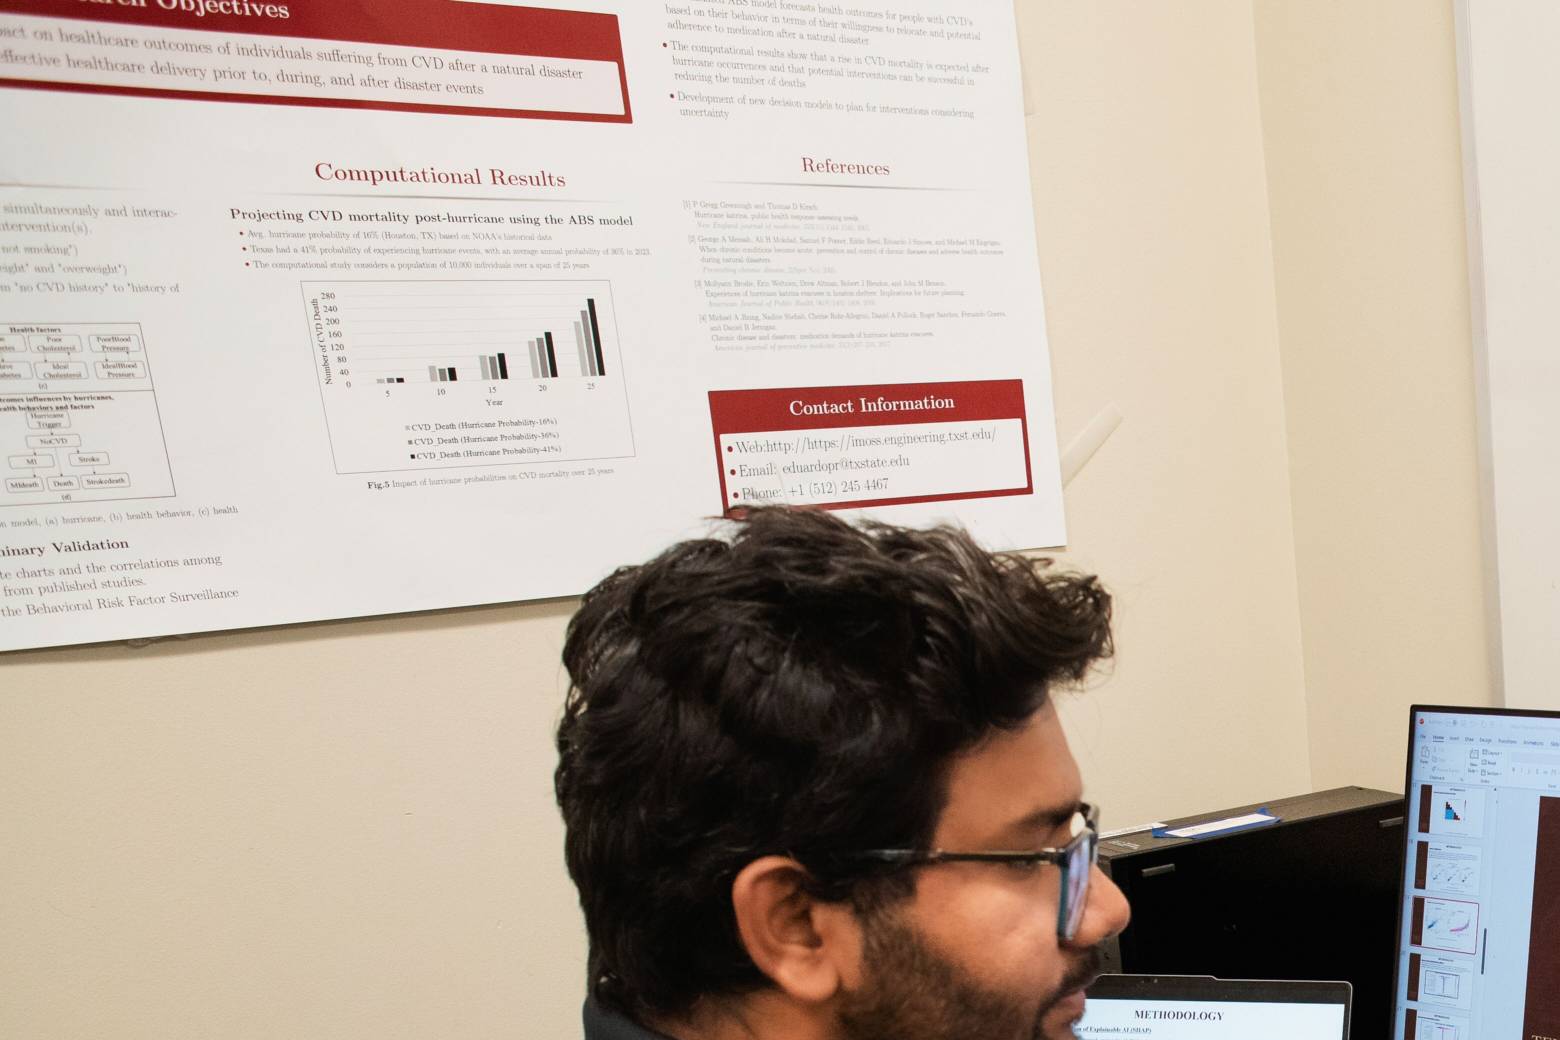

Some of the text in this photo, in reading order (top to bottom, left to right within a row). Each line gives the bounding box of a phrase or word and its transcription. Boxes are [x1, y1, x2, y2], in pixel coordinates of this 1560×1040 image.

[150, 0, 290, 19] Objectives
[665, 4, 691, 17] based
[731, 11, 768, 24] behavior
[33, 27, 584, 80] on healthcare outcomes of individuals suffering from CVD after a natural disaster
[65, 54, 145, 74] healthcare
[150, 60, 207, 79] delivery
[213, 67, 247, 82] prior
[330, 73, 355, 87] and
[359, 75, 389, 89] after
[394, 77, 441, 93] disaster
[445, 83, 485, 95] events
[315, 162, 566, 187] Computational Results
[801, 156, 890, 177] References
[3, 202, 178, 219] simultaneously and interac-
[230, 208, 634, 226] Projecting CVD mortality post-hurricane using the ABS model
[36, 282, 65, 293] CVD
[113, 282, 125, 293] to
[322, 305, 338, 313] 240
[325, 318, 340, 326] 200
[311, 298, 333, 385] Number of CVD Death
[436, 388, 446, 396] 10
[538, 384, 547, 392] 20
[486, 398, 504, 407] Year
[789, 395, 955, 416] Contact Information
[411, 422, 457, 433] CVD_Death
[458, 420, 496, 431] (Hurricane
[414, 435, 459, 447] CVD_Death
[460, 434, 498, 445] (Hurricane
[735, 426, 997, 455] Web:http://https://imoss.engineering.txst.edu/
[416, 450, 461, 461] CVD_Death
[462, 448, 501, 459] (Hurricane
[739, 455, 910, 478] Email: eduardopr@txstate.edu
[788, 484, 805, 497] +1
[809, 480, 838, 498] (512)
[842, 480, 862, 493] 245
[863, 478, 889, 491] 4467
[51, 538, 130, 554] Validation
[16, 554, 223, 579] charts and the correlations among
[4, 584, 33, 598] from
[38, 578, 97, 597] published
[1, 589, 239, 618] the Behavioral Risk Factor Surveillance
[1134, 1009, 1224, 1021] METHODOLOGY
